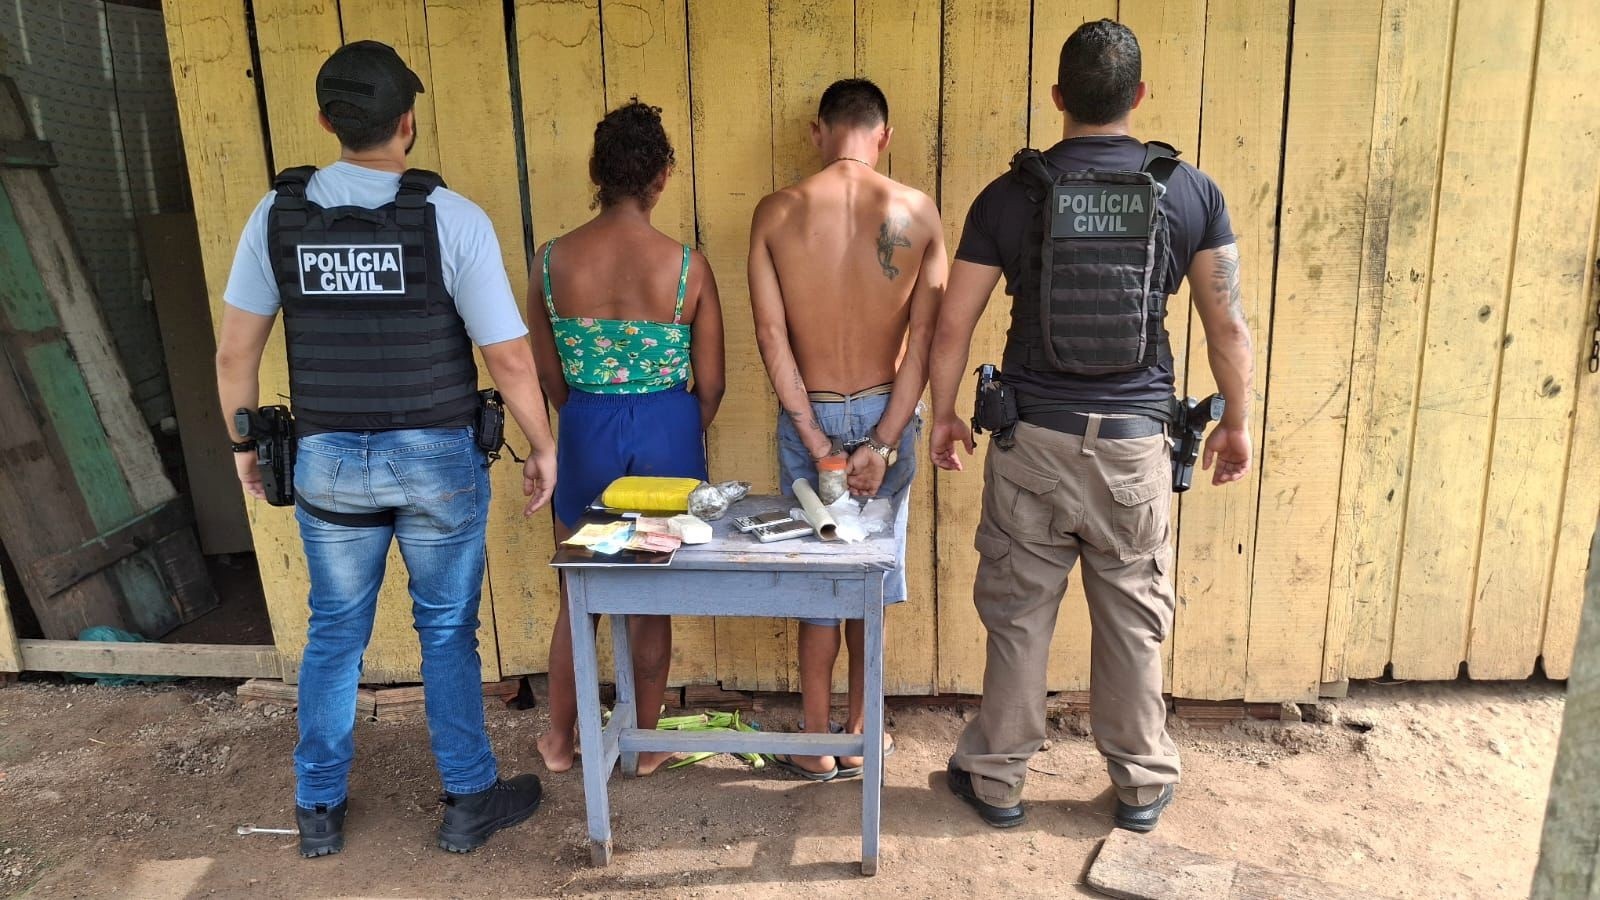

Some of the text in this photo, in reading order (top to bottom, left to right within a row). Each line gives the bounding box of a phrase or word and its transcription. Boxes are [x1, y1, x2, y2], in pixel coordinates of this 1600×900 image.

[1059, 190, 1144, 213] POLÍCIA
[1073, 216, 1127, 232] CIVIL
[303, 249, 399, 272] POLÍCIA
[321, 272, 383, 291] CIVIL
